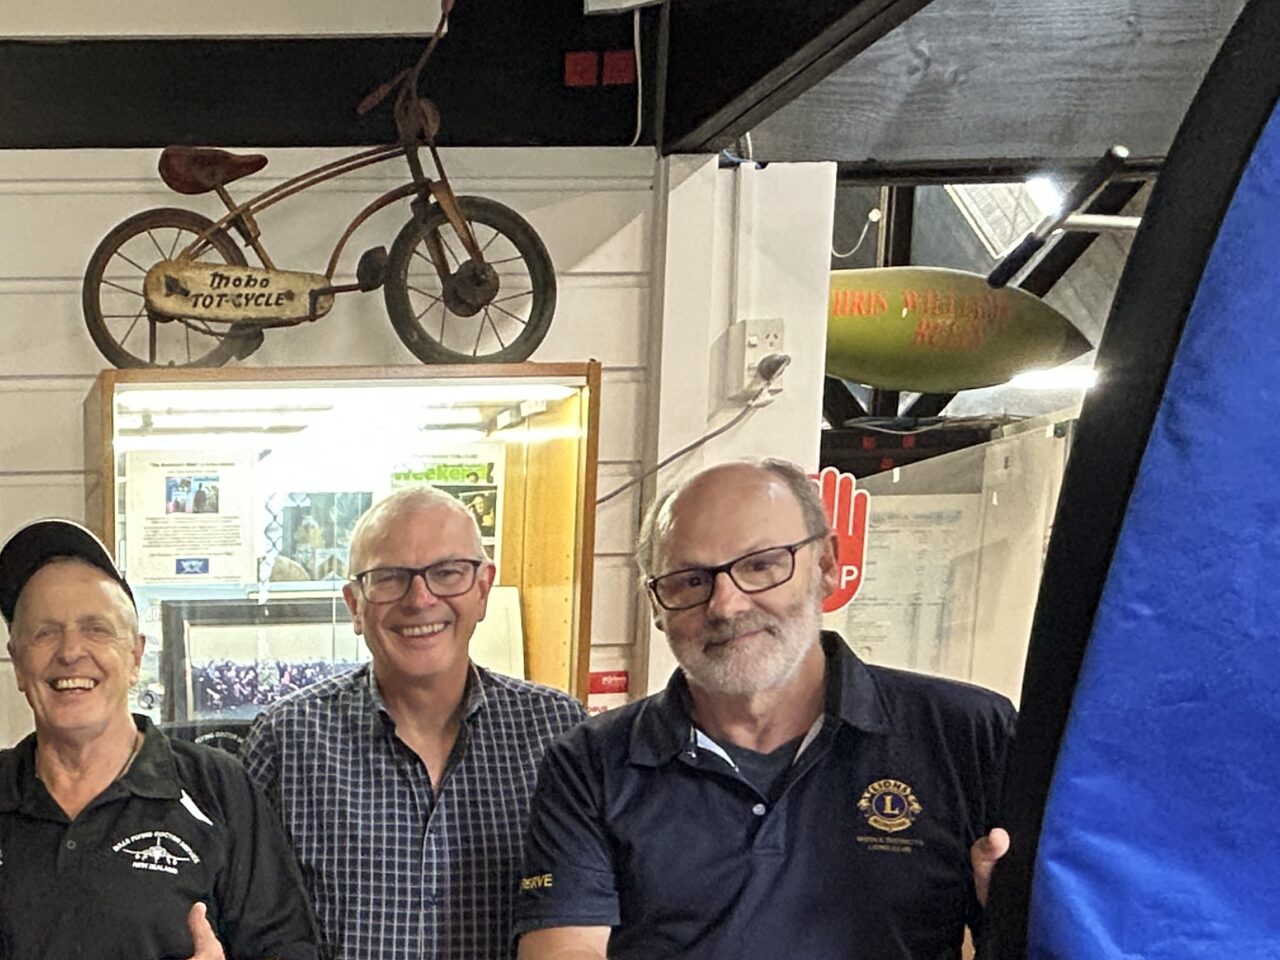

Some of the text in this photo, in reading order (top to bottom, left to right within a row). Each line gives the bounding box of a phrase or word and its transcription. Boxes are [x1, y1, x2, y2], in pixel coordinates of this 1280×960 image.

[209, 271, 270, 290] Mobo
[191, 293, 286, 309] TOT-CYCLE
[883, 795, 899, 814] L
